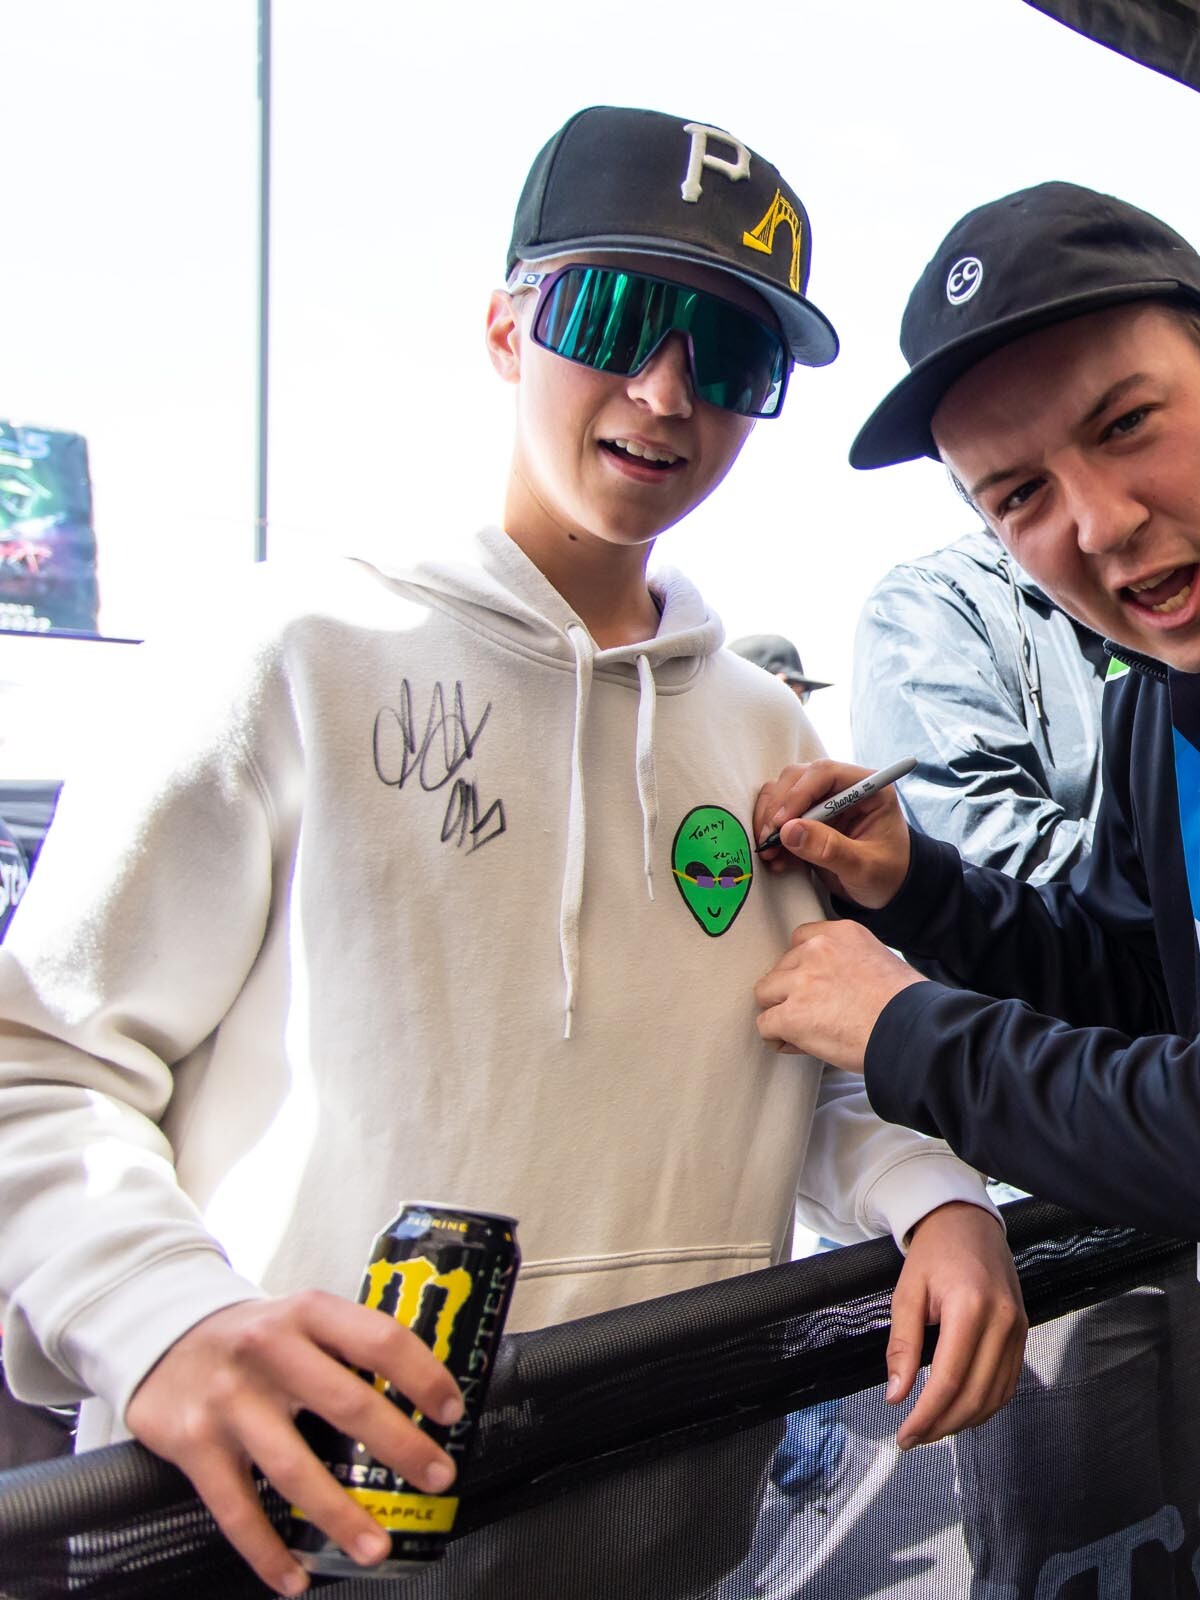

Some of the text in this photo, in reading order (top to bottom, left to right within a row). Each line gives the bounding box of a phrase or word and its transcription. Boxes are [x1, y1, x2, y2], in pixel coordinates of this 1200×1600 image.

[681, 123, 751, 203] P
[824, 789, 861, 816] Sharpie
[407, 1217, 469, 1233] TAURINE
